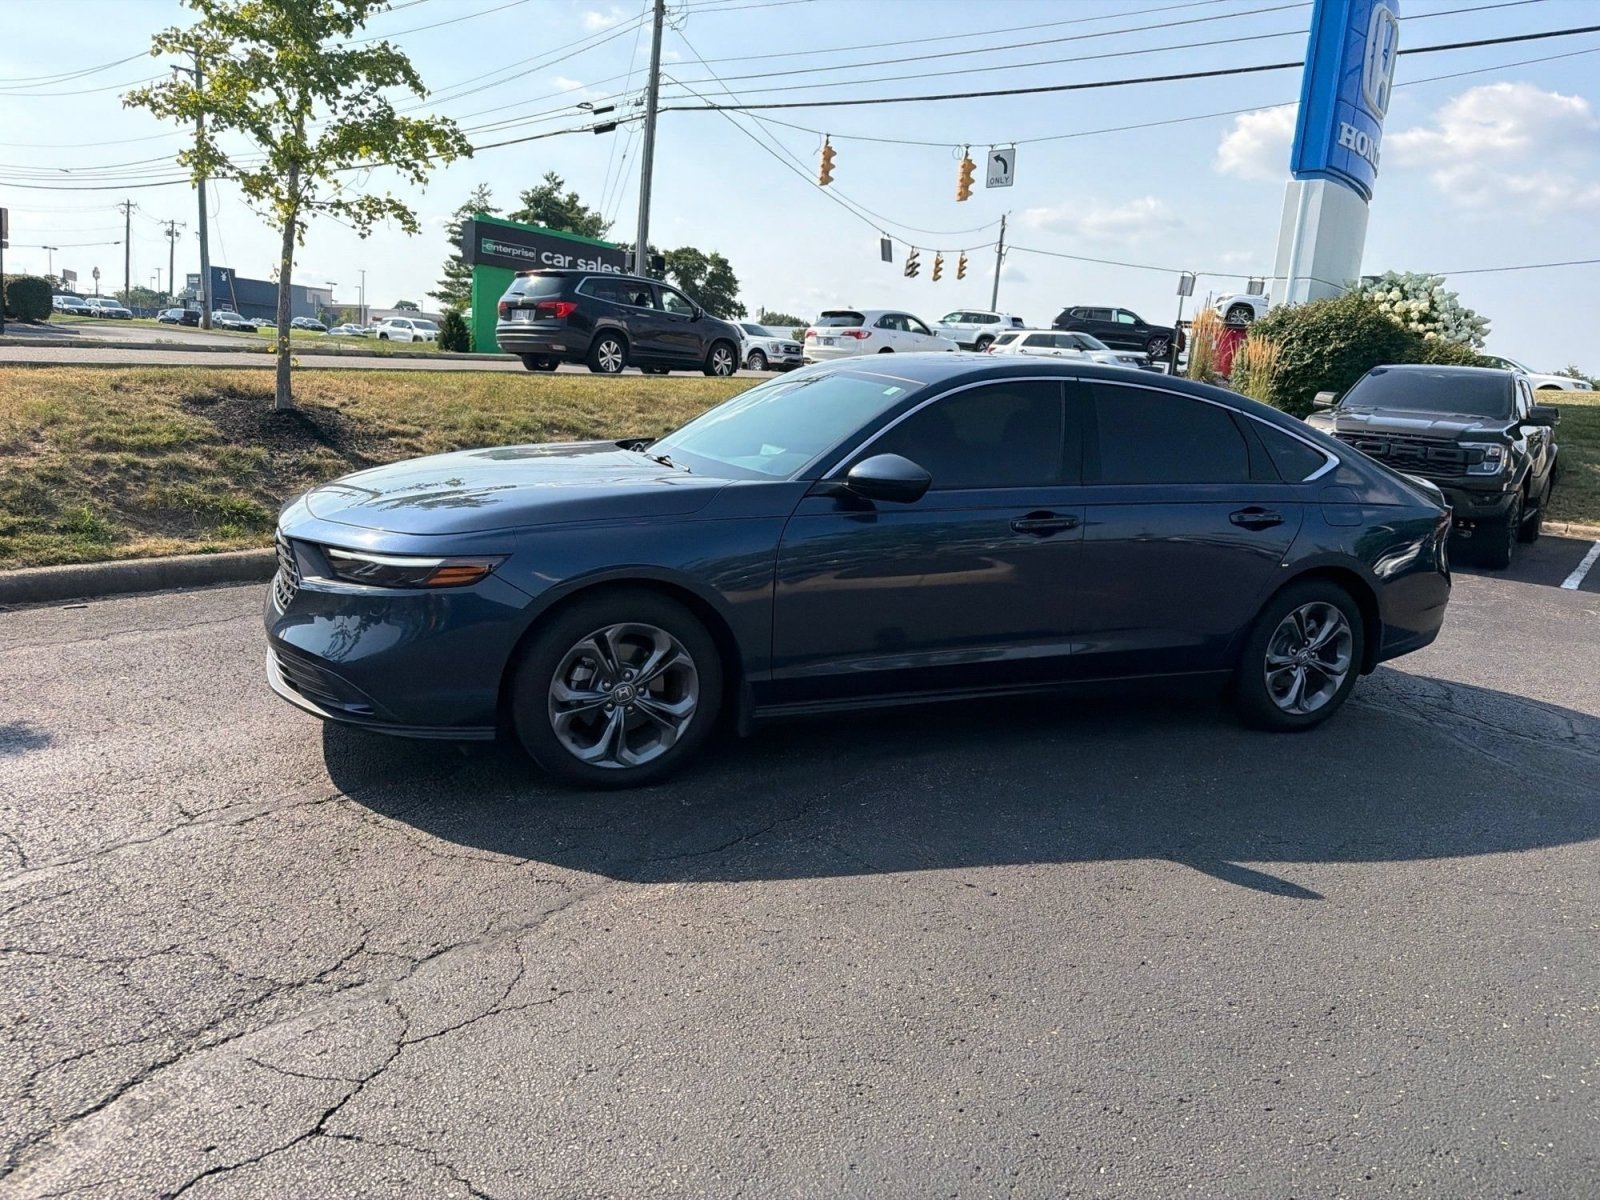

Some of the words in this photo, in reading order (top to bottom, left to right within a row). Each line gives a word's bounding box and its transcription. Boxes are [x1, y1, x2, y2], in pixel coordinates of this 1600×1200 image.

[990, 176, 1009, 185] ONLY
[485, 242, 535, 258] enterprise
[540, 251, 573, 268] car
[576, 256, 621, 275] sales
